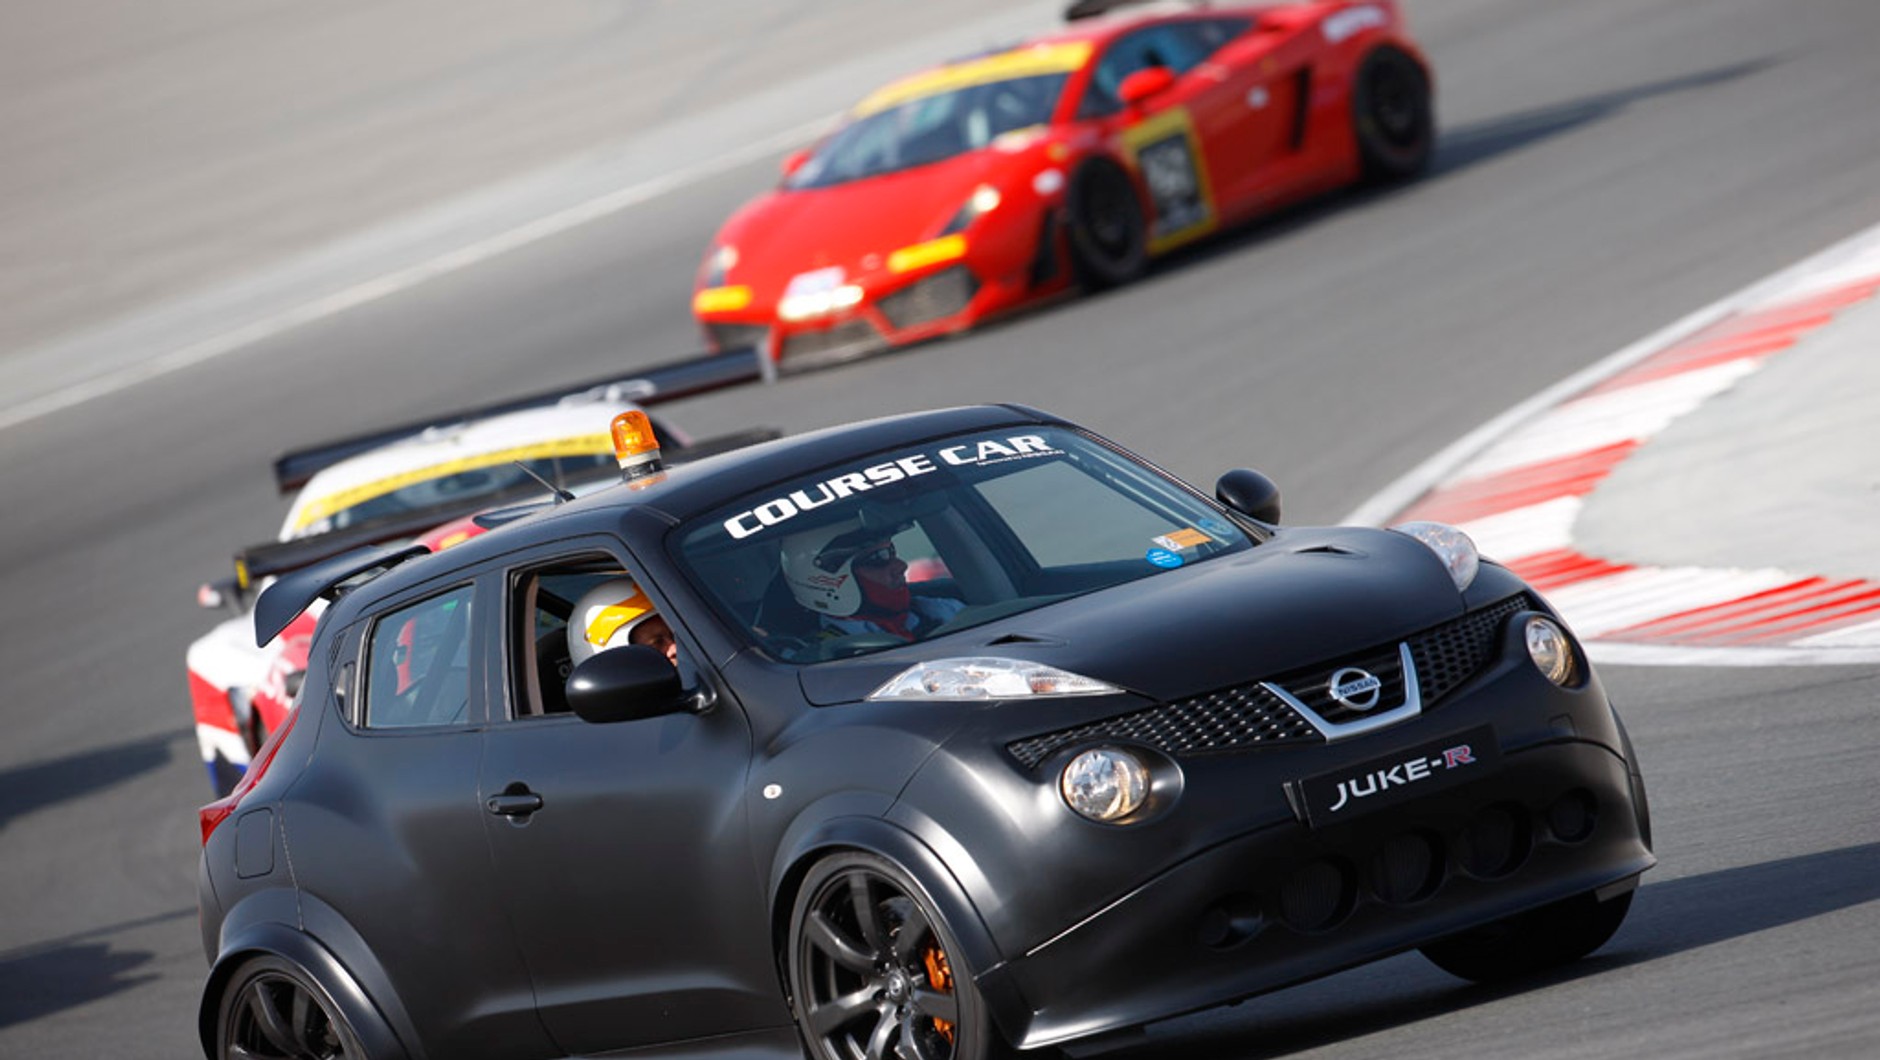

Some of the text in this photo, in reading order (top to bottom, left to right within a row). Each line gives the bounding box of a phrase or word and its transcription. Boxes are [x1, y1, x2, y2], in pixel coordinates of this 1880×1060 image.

[723, 434, 1055, 539] COURSE CAR
[1337, 679, 1378, 696] NISSAN
[1329, 745, 1476, 812] JUKE-R
